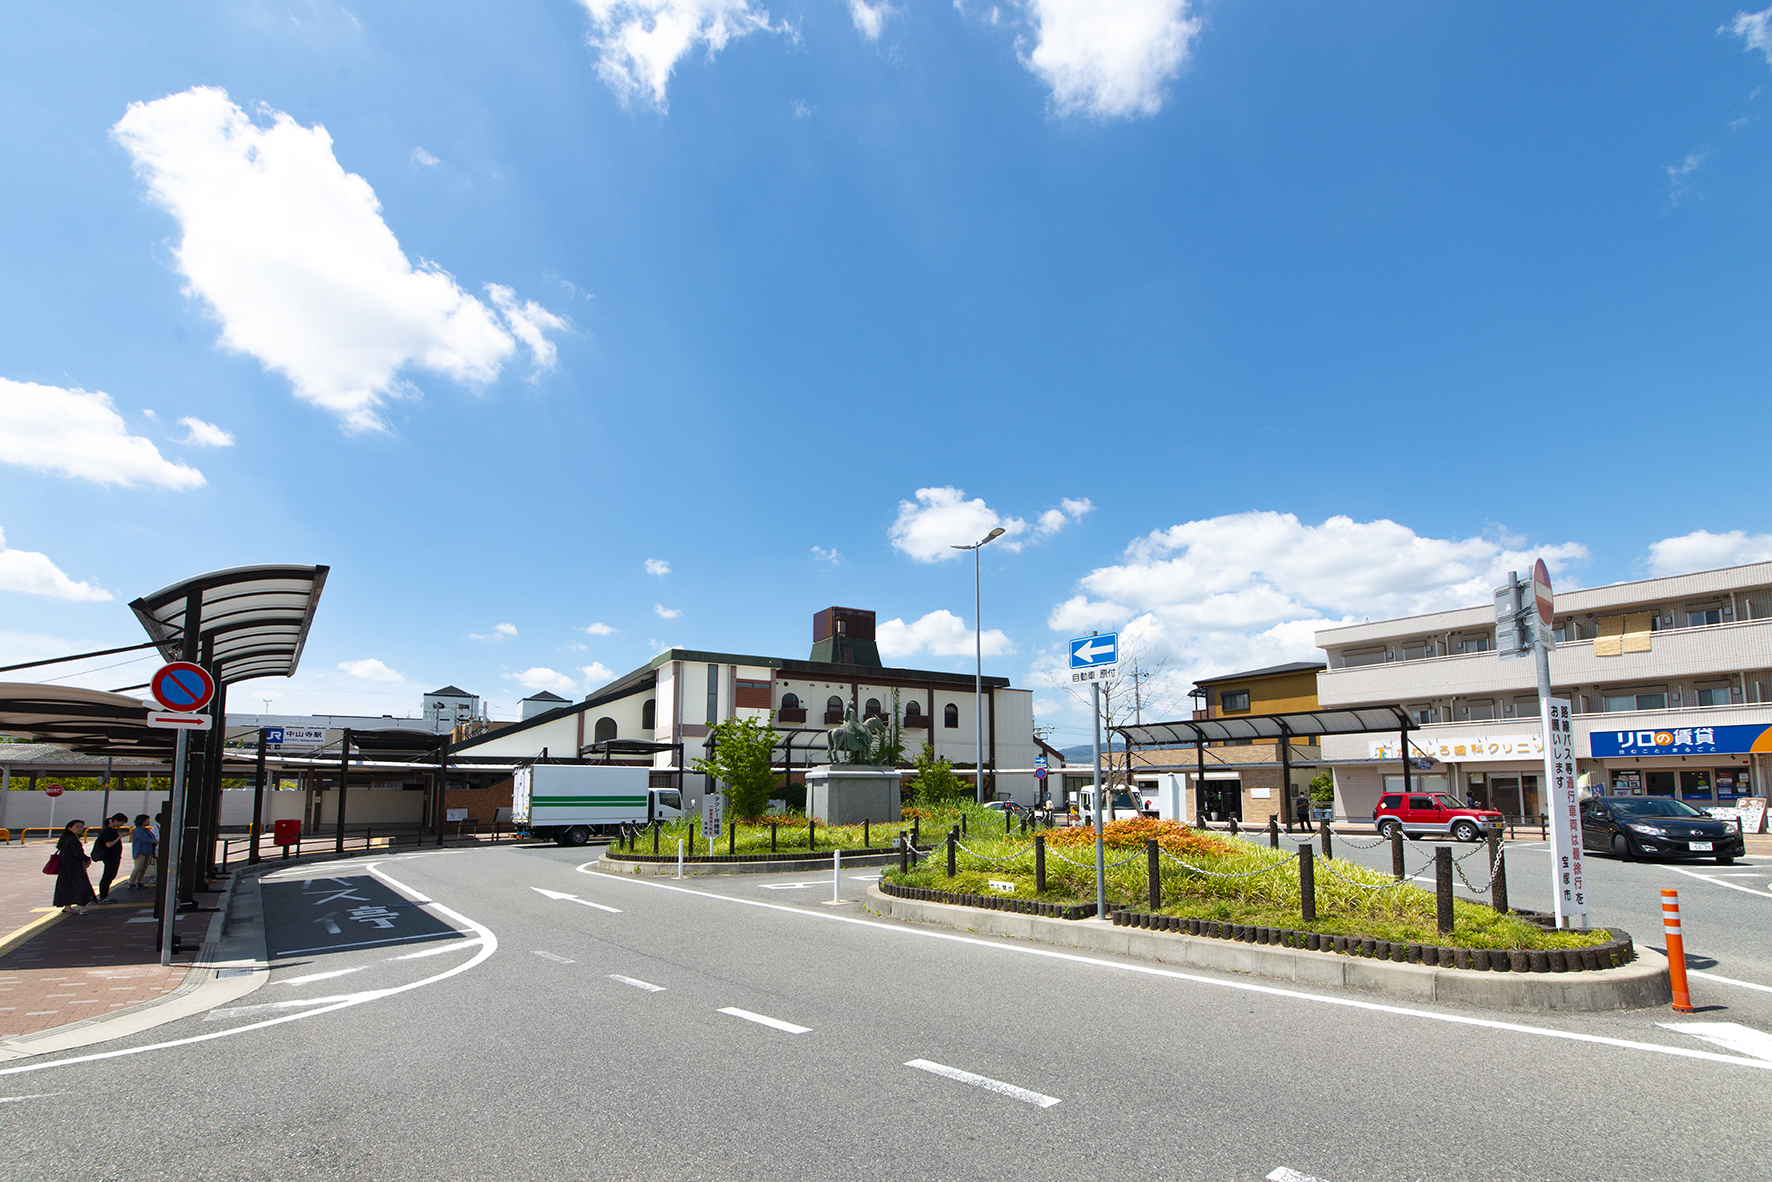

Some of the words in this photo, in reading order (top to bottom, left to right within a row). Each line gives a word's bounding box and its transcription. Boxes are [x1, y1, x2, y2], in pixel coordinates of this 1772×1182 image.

[266, 731, 282, 740] JR
[1551, 705, 1564, 788] お願いします
[1617, 728, 1715, 748] リロの賃貸
[1561, 705, 1584, 905] 路線バス等通行車両は最徐行を
[1562, 856, 1571, 902] 宝塚市
